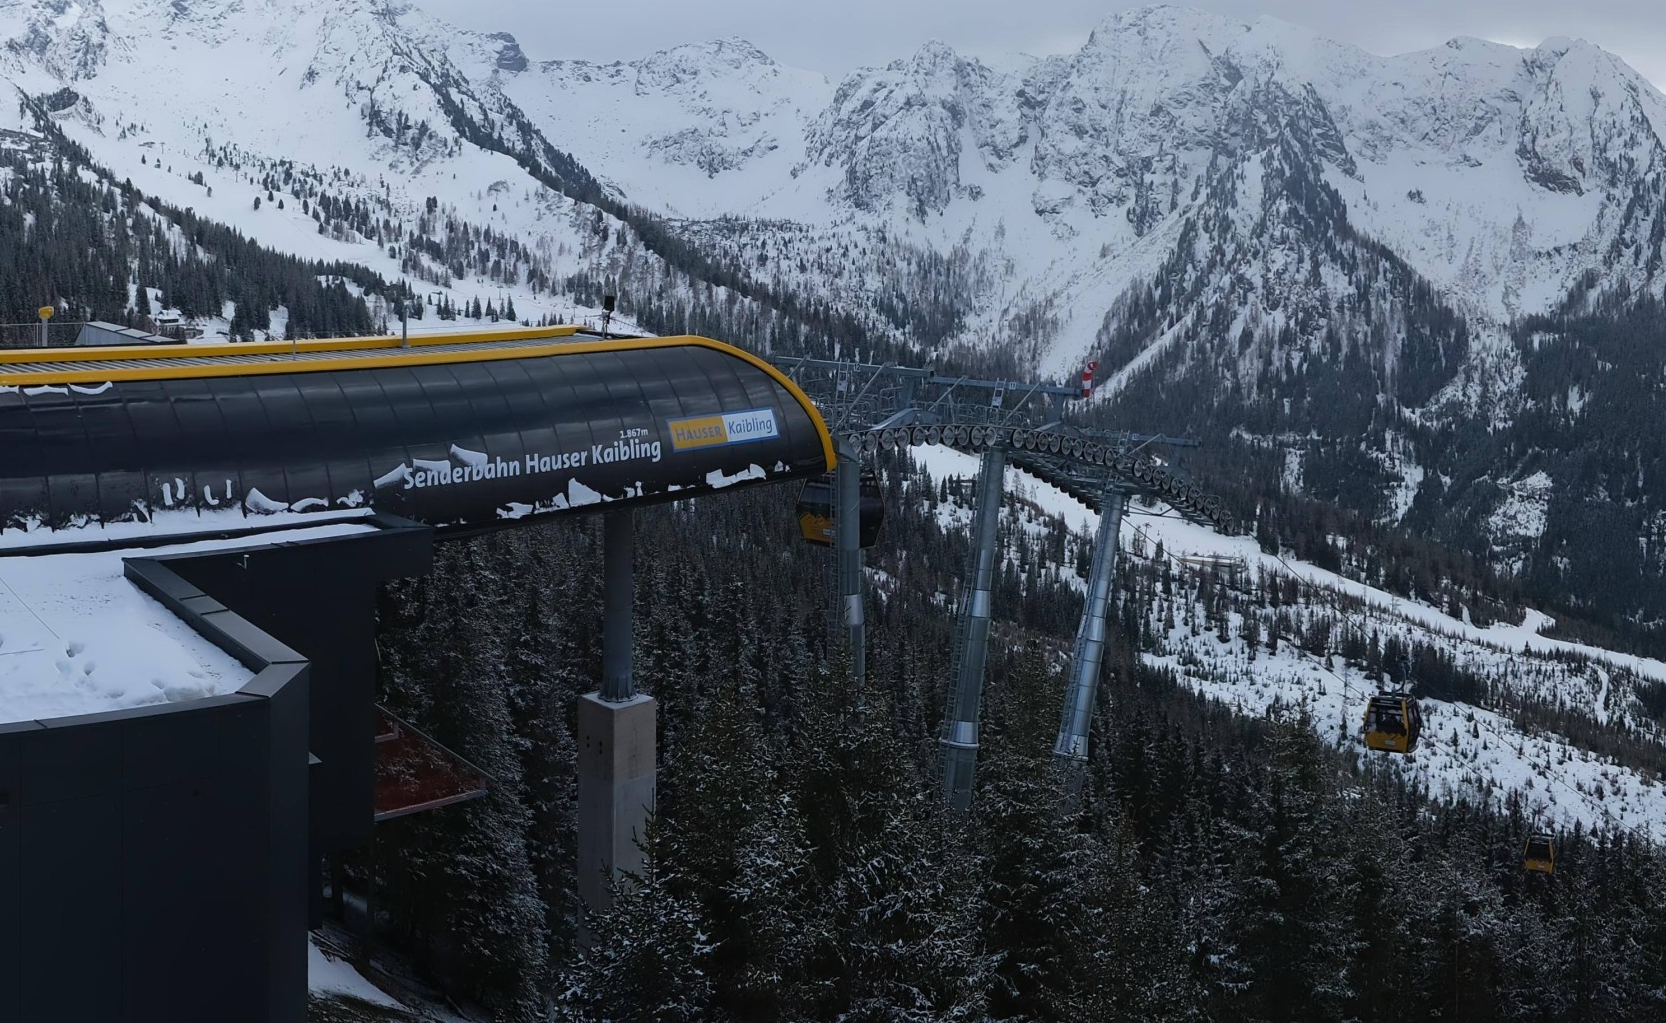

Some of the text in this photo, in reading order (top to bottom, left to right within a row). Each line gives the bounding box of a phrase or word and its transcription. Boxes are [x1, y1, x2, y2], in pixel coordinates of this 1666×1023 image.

[675, 414, 773, 443] HAUSER Kaibling
[404, 439, 661, 490] Senderbahn Hauser Kaibling
